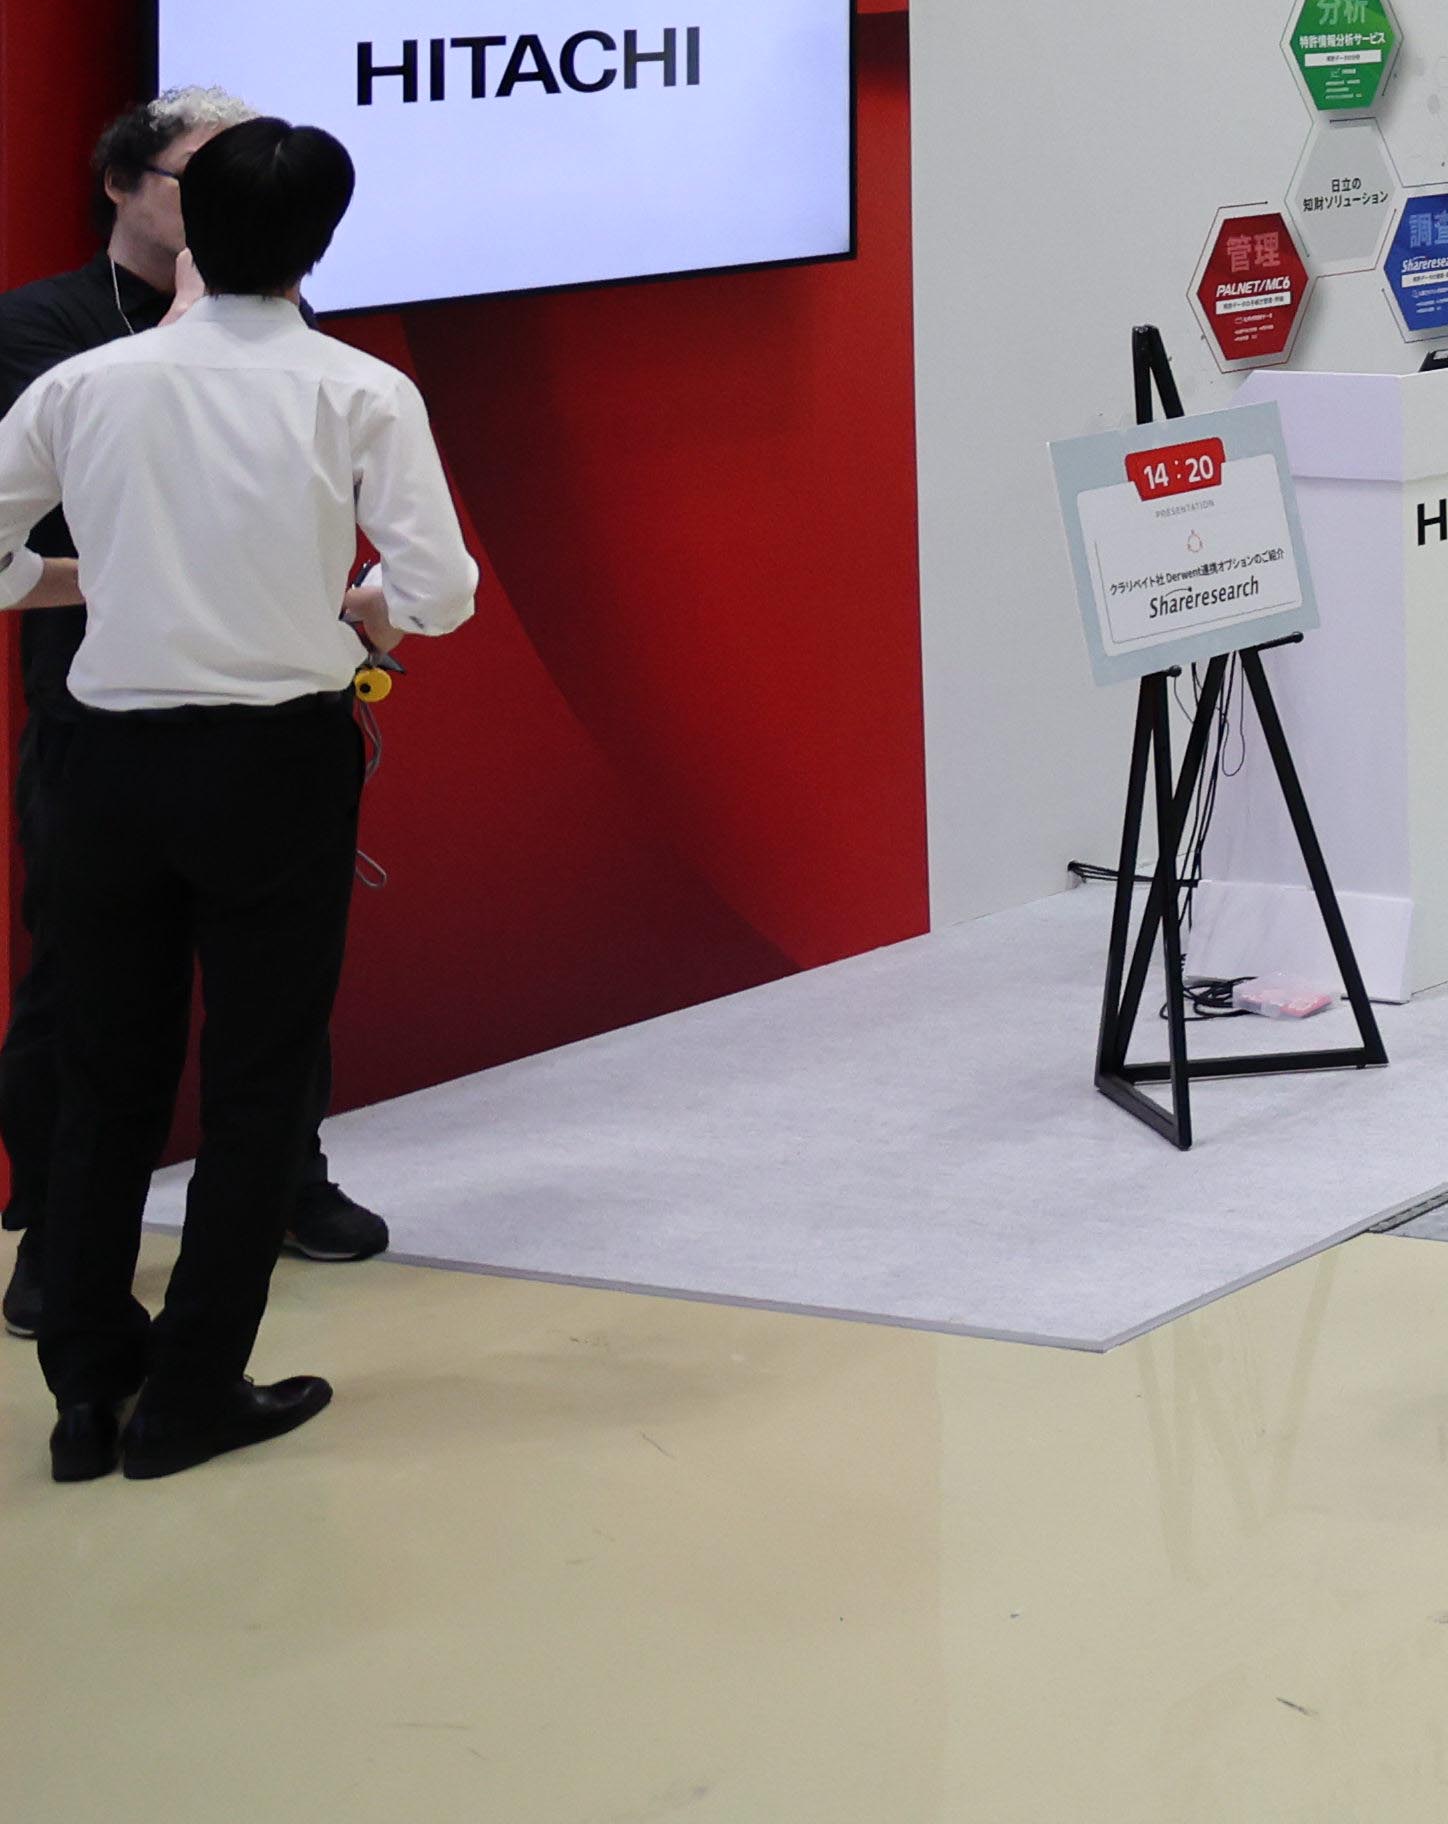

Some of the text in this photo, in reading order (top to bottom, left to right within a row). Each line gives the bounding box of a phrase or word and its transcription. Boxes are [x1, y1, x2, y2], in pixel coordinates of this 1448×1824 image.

[1299, 32, 1386, 49] 特許情報分析サービス
[356, 26, 701, 106] HITACHI
[1331, 177, 1362, 192] 日立の
[1303, 190, 1389, 212] 知財ソリューション
[1227, 232, 1281, 273] 管理
[1216, 276, 1291, 297] PALNET/MC6
[1155, 500, 1215, 519] PRESENTATION
[1149, 576, 1260, 619] Shareresearch
